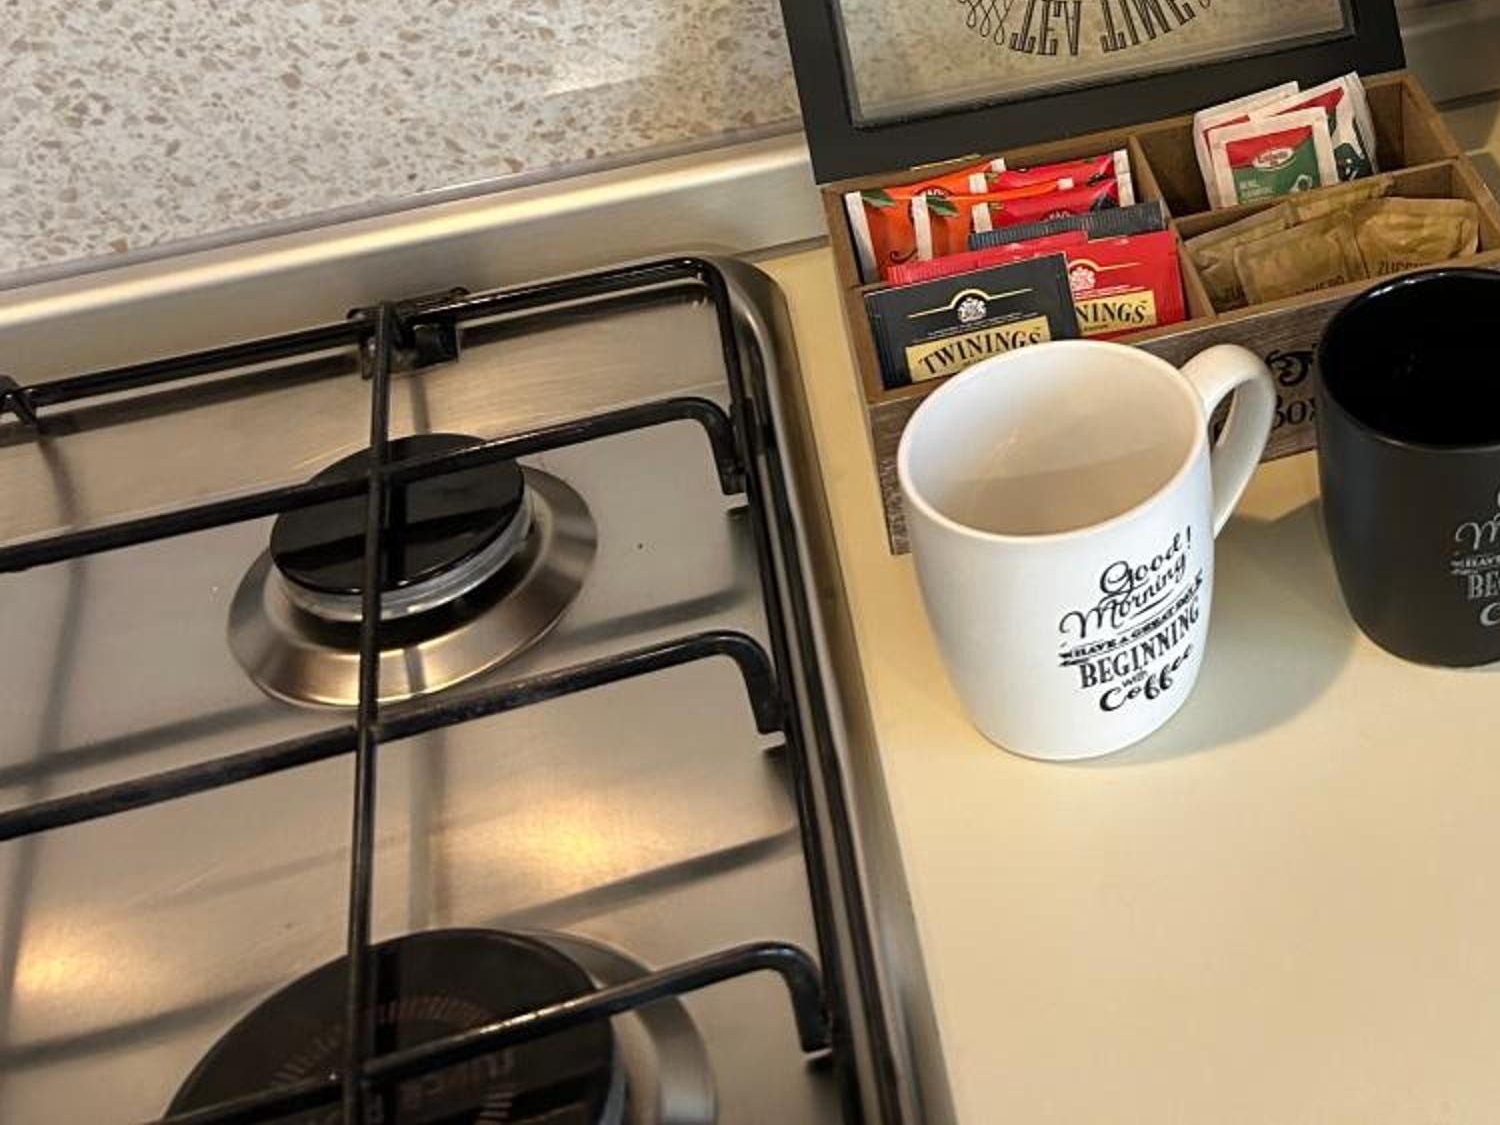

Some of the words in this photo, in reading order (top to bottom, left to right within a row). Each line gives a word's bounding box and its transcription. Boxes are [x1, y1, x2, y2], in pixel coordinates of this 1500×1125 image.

[1075, 302, 1147, 324] NINGS
[918, 330, 1041, 374] TWININGS
[1059, 552, 1187, 640] Morning
[1100, 525, 1193, 597] Good!
[1080, 602, 1200, 689] BEGINNING
[1099, 644, 1193, 712] Coffee
